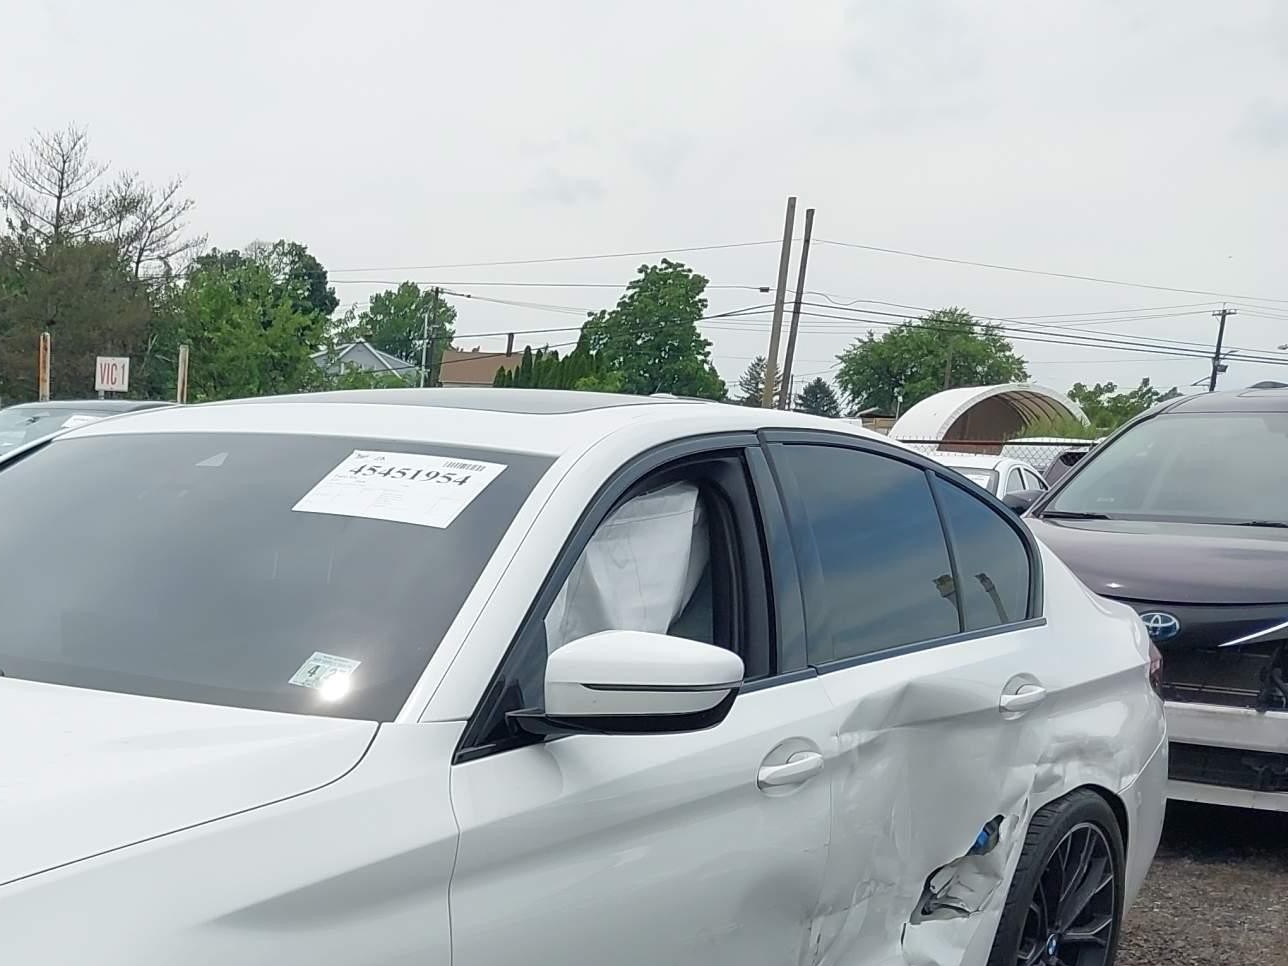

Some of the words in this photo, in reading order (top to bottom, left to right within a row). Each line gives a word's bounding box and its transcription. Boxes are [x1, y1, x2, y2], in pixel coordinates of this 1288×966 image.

[100, 362, 117, 385] VIC
[120, 363, 126, 385] 1
[349, 463, 472, 487] 45451954
[307, 664, 321, 677] 4
